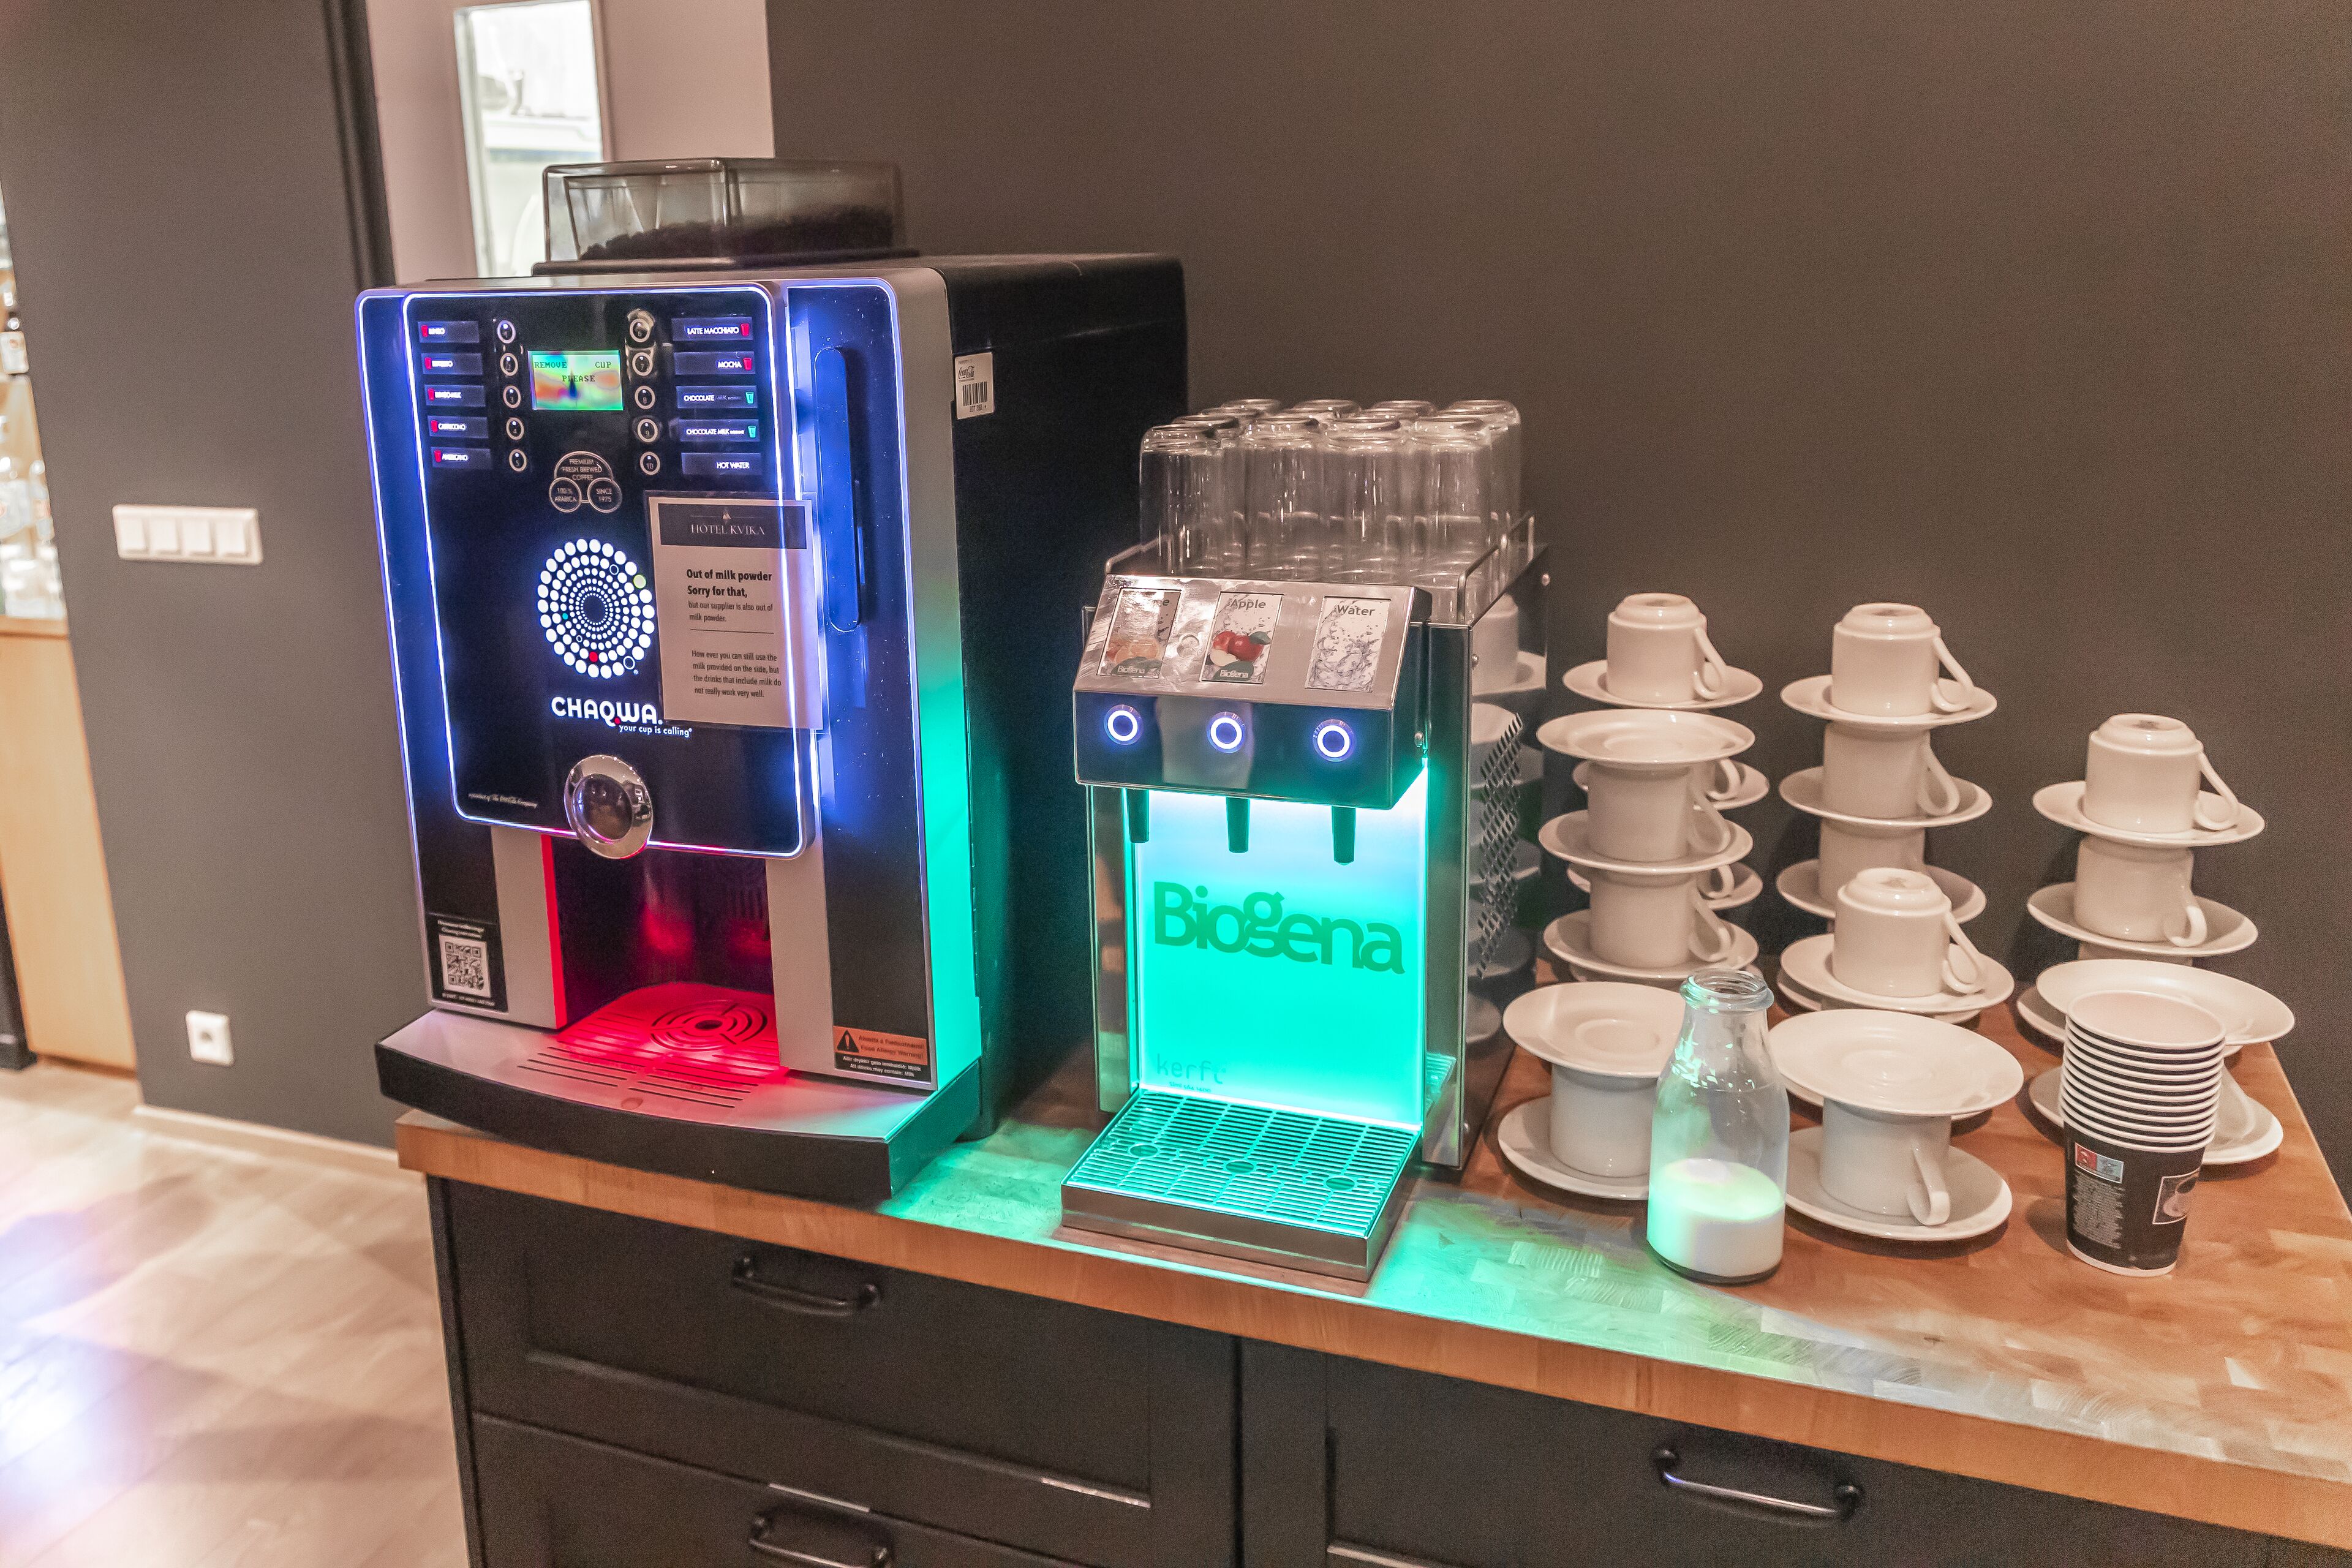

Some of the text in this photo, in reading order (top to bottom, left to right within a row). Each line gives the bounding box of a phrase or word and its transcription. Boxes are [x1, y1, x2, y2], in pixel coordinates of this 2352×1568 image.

[691, 524, 765, 535] HOTEL KVIKA
[687, 569, 772, 582] Out of milk powder
[687, 586, 747, 598] Sorry for that,
[710, 602, 734, 611] supplier
[1231, 599, 1266, 610] Apple
[1336, 605, 1375, 616] Water
[704, 614, 727, 623] powder.
[706, 663, 732, 672] provided
[753, 665, 767, 674] side,
[705, 688, 720, 697] really
[638, 726, 652, 735] cup
[654, 726, 662, 734] is
[663, 727, 690, 738] calling
[1153, 881, 1406, 975] Biogena
